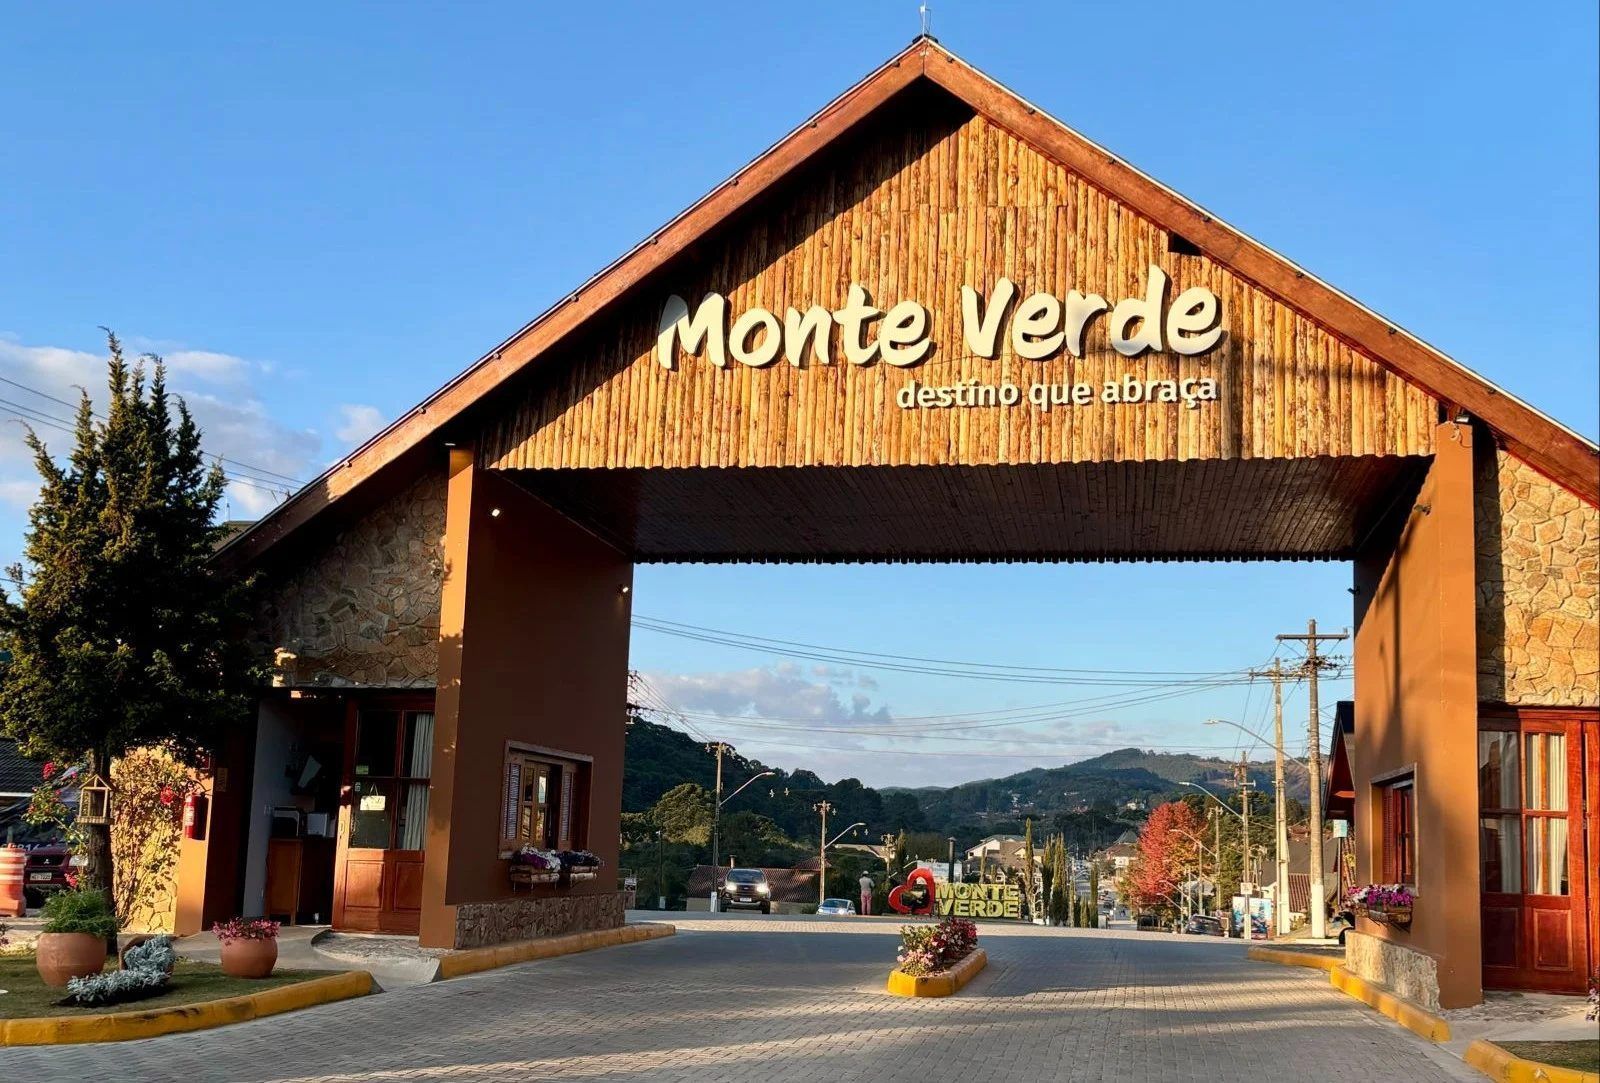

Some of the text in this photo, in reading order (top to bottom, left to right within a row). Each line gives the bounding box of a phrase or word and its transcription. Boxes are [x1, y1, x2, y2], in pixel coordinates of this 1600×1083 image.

[657, 264, 1223, 370] Monte Verde
[896, 374, 1217, 412] destino que abraça
[935, 882, 1019, 900] MONTE
[936, 900, 1019, 918] VERDE
